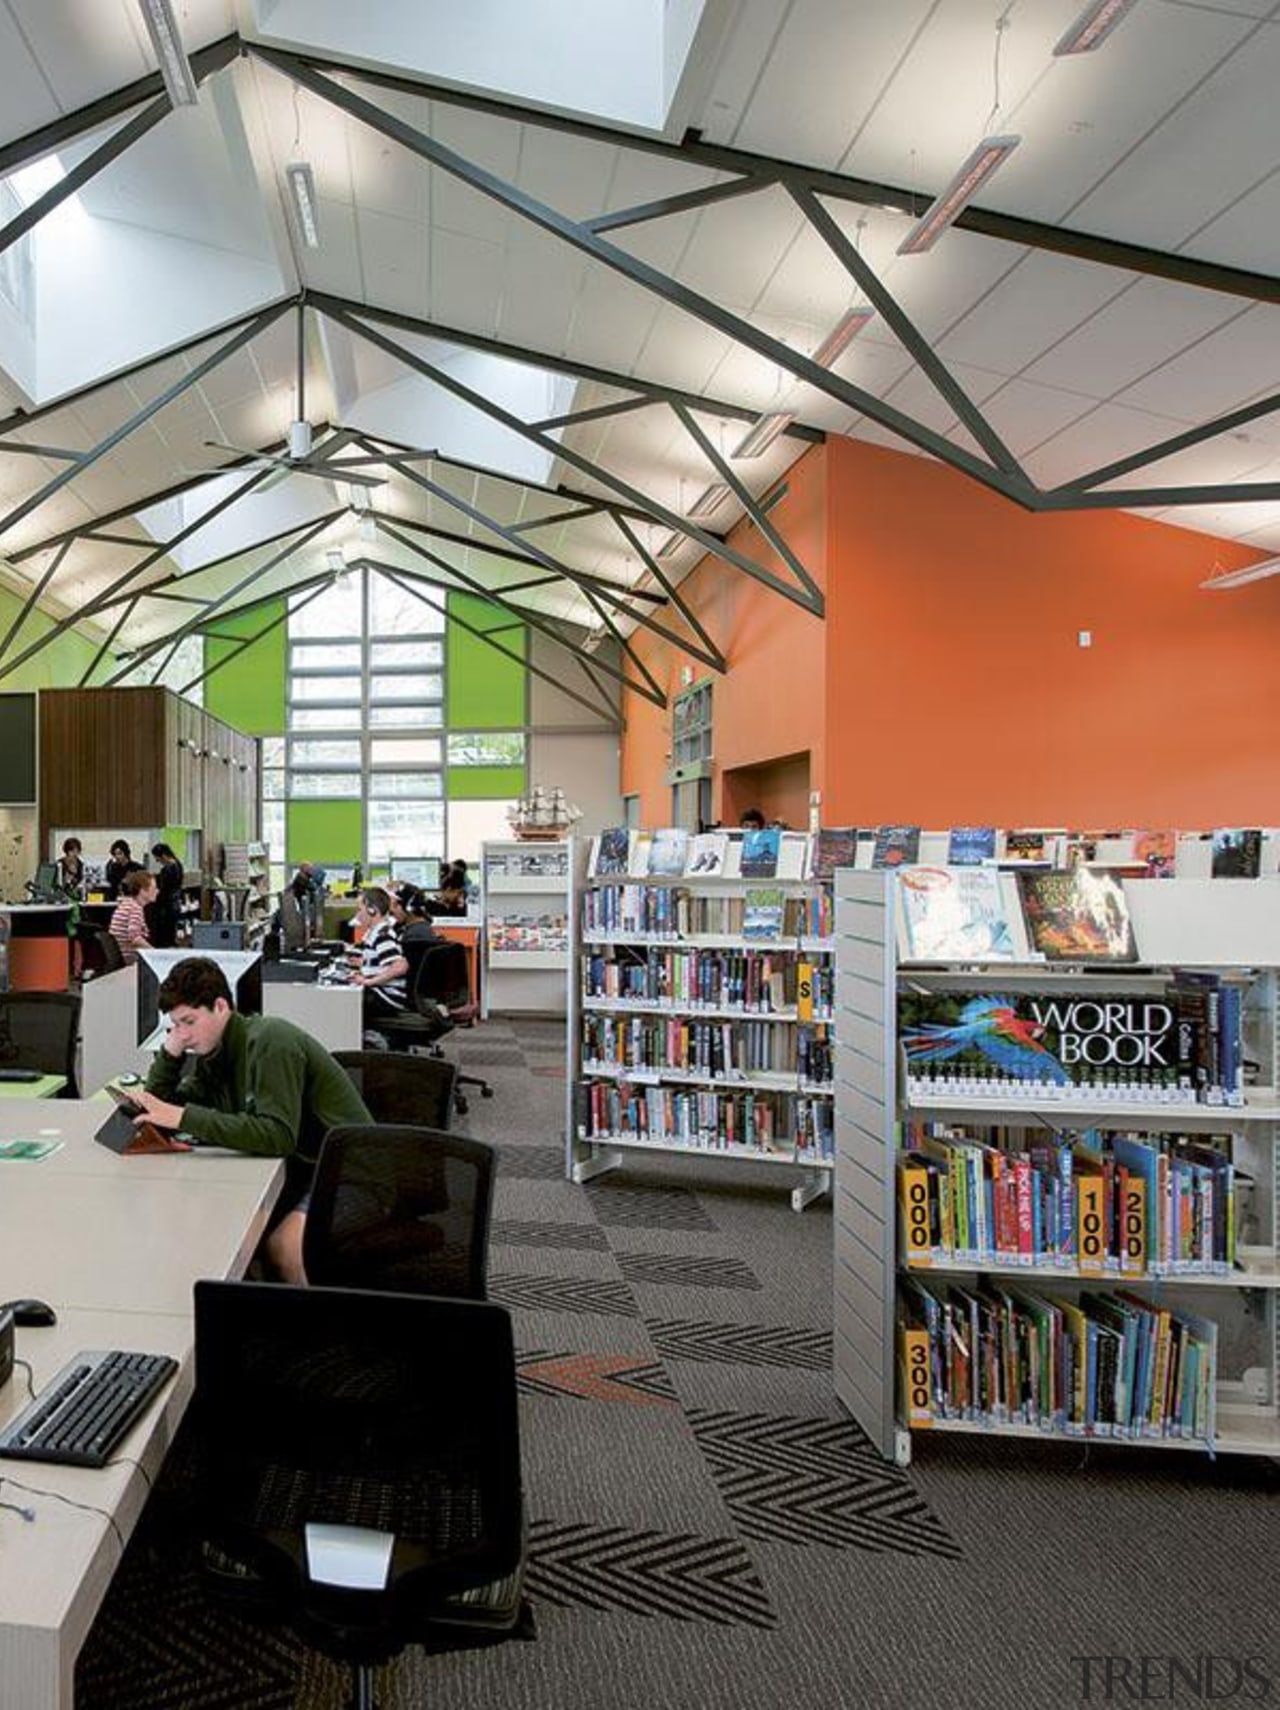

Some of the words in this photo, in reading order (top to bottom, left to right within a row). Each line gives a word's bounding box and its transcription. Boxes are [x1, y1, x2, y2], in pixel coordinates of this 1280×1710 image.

[800, 981, 811, 998] S
[1031, 1002, 1172, 1035] WORLD
[1060, 1033, 1168, 1065] BOOK
[910, 1183, 927, 1247] 000
[1083, 1192, 1100, 1255] 100
[1127, 1193, 1142, 1257] 200
[910, 1345, 928, 1407] 300
